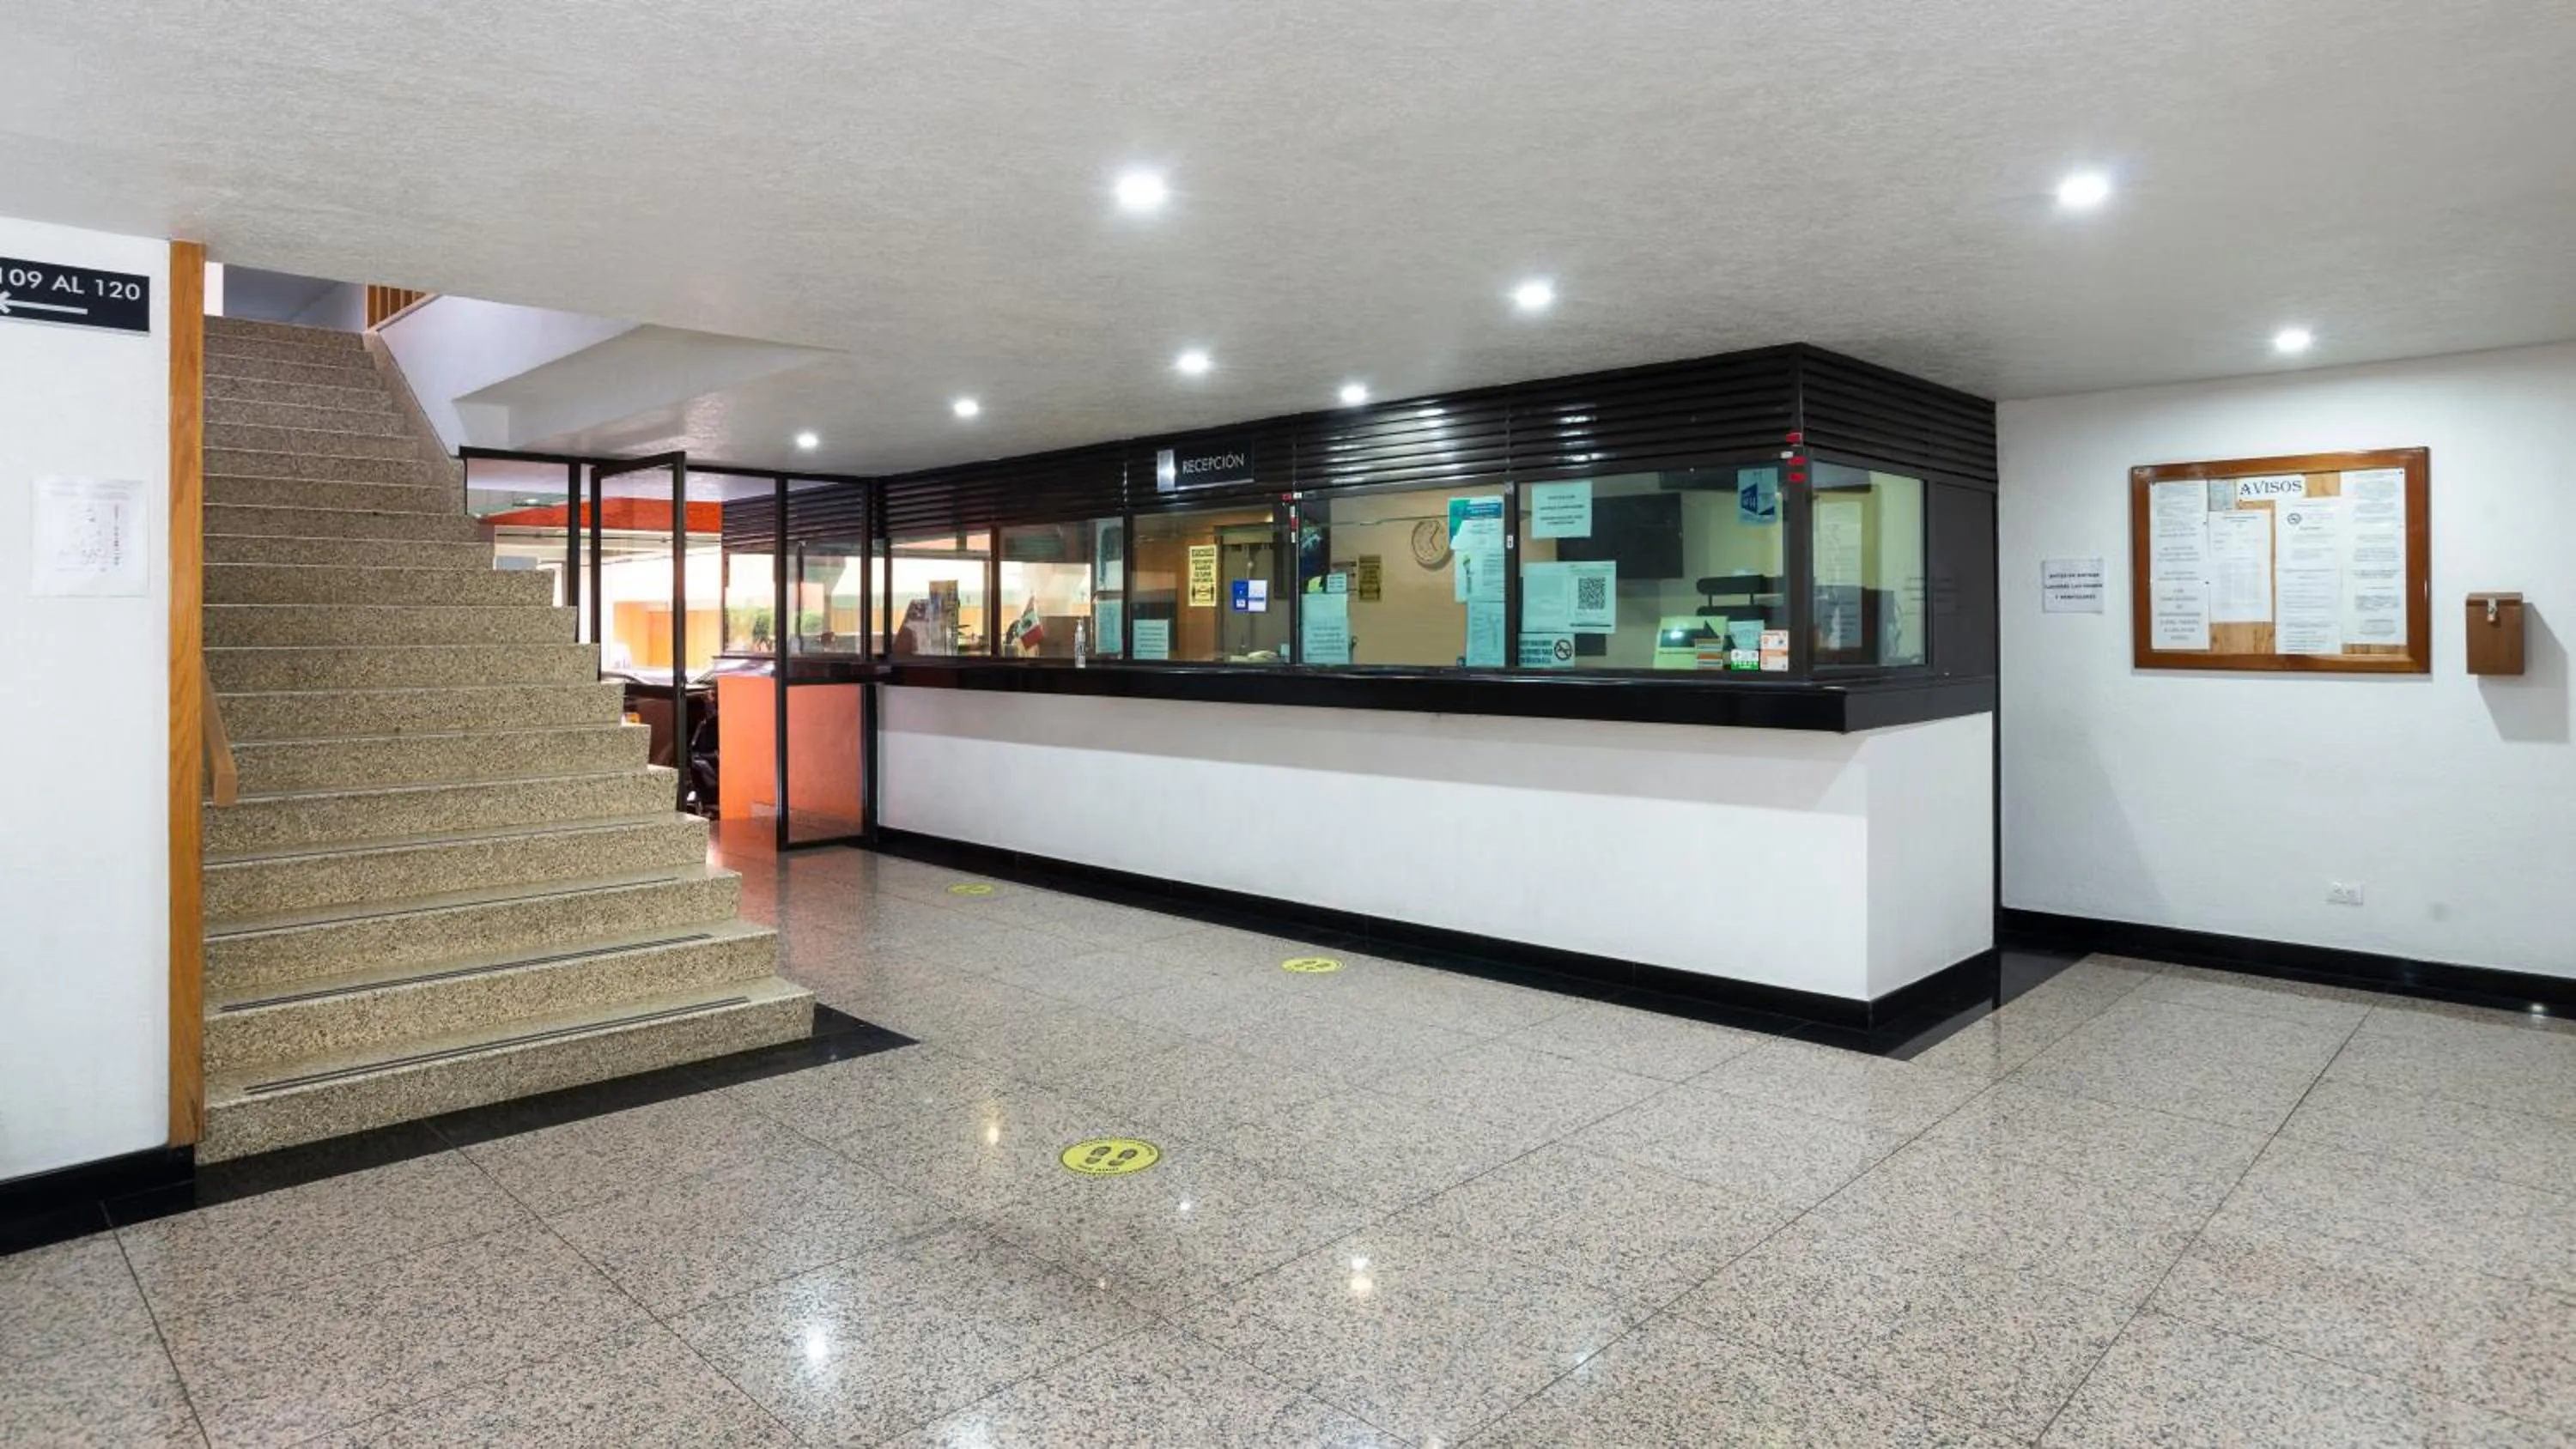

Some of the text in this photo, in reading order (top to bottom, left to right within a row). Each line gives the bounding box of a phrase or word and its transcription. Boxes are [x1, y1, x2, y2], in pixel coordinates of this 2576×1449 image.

[52, 276, 84, 294] AL
[95, 279, 140, 300] 120
[1182, 452, 1244, 474] RECEPCIÓN
[2239, 481, 2302, 494] AVISOS
